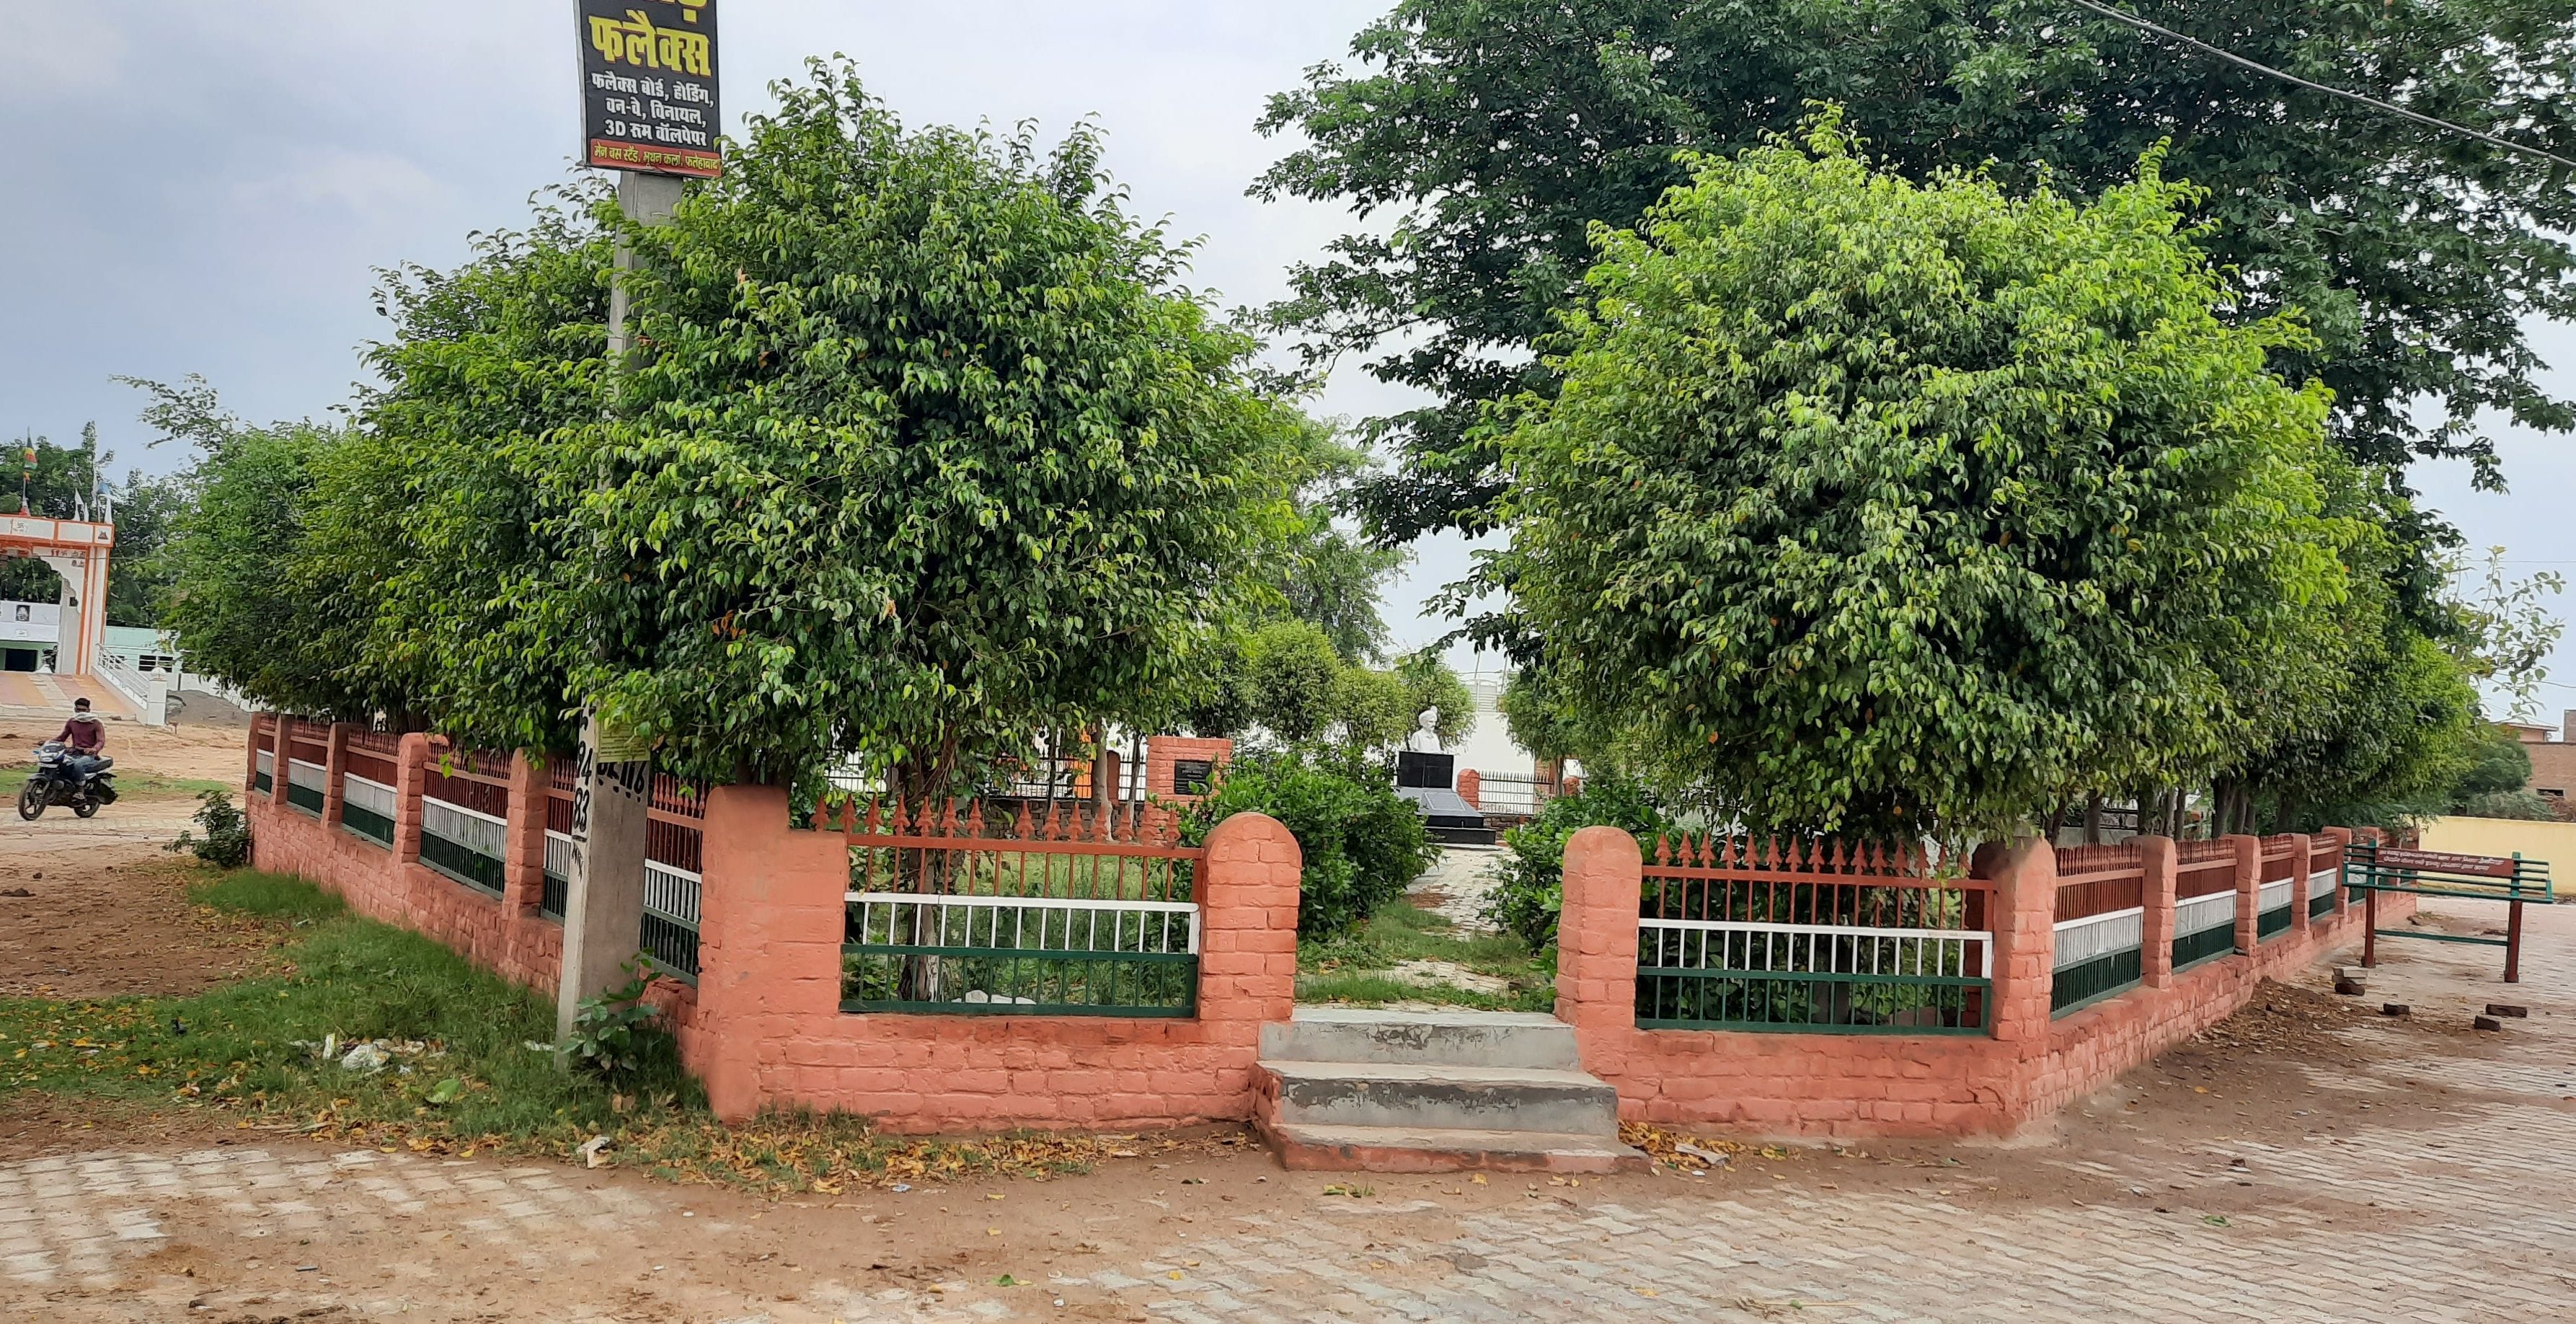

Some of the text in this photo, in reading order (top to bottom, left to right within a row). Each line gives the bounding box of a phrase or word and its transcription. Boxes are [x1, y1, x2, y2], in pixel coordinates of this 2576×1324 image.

[588, 9, 712, 77] फलैक्स
[591, 71, 638, 94] फलैक्स
[604, 119, 627, 137] 3D
[573, 787, 590, 833] 83
